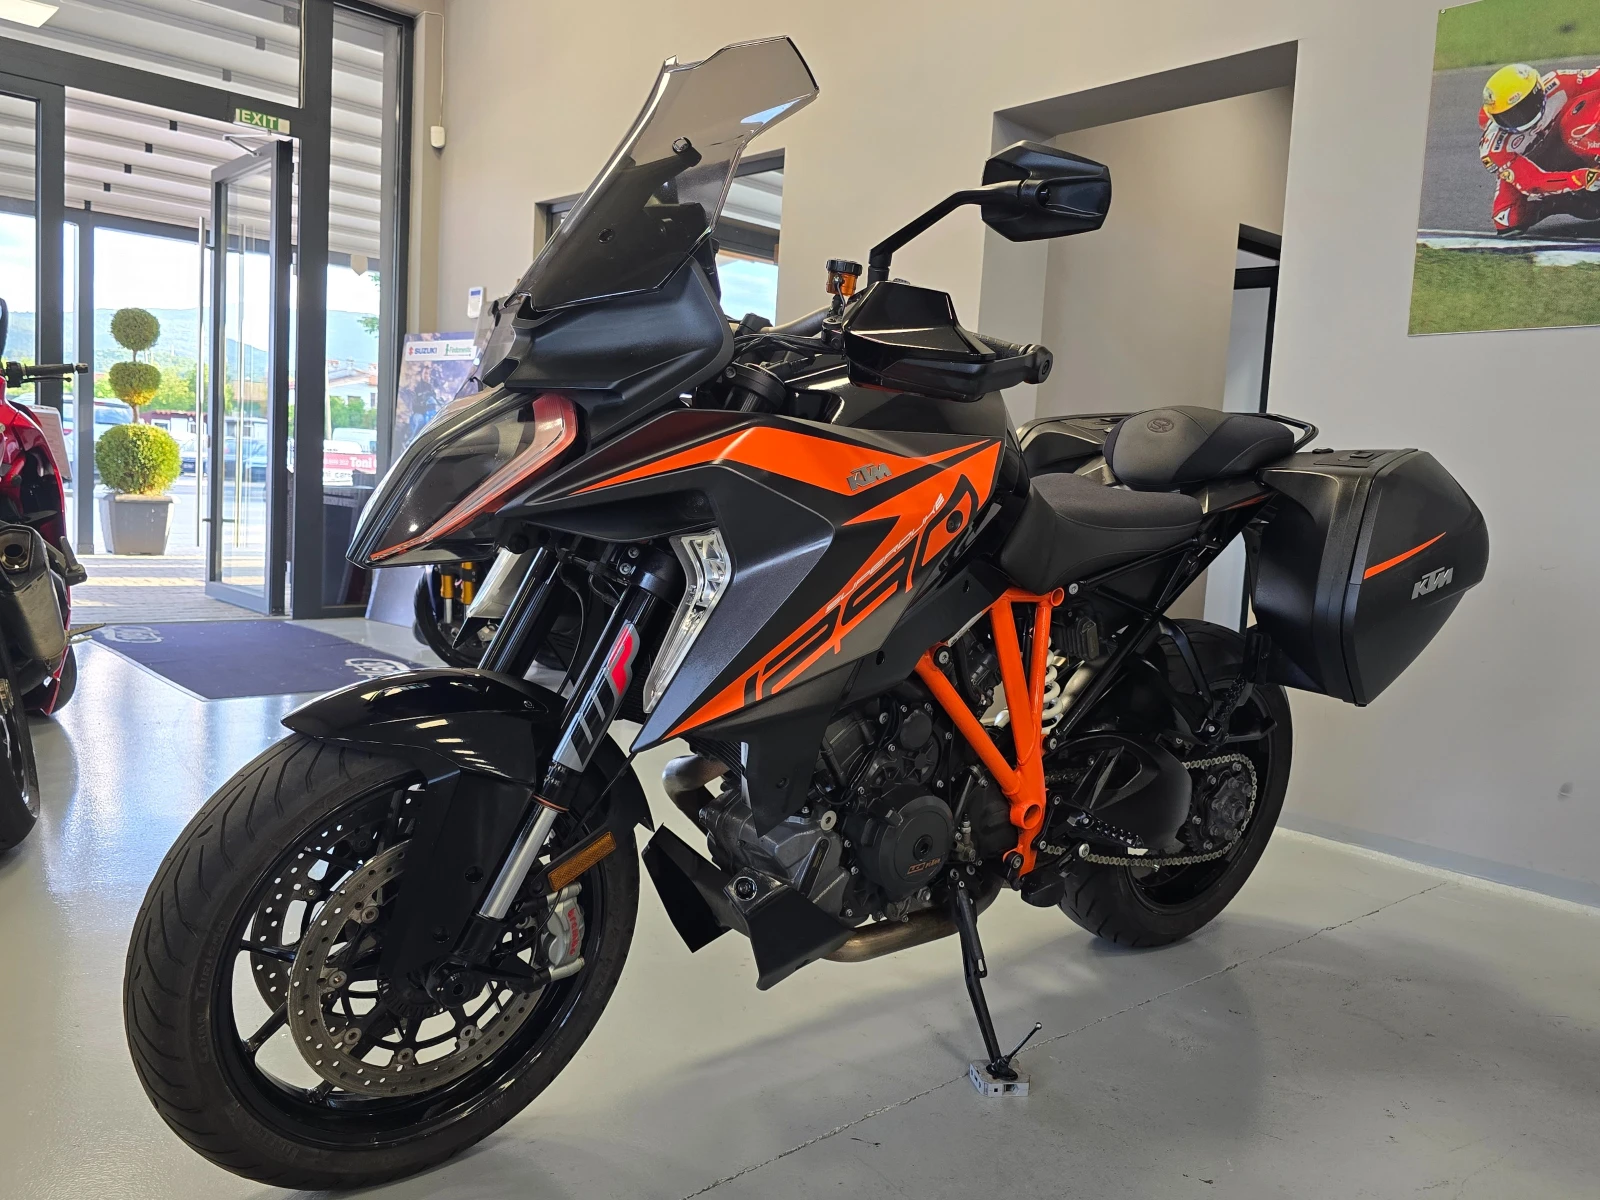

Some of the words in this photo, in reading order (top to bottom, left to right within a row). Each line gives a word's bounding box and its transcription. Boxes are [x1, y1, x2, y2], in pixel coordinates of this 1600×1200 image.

[241, 109, 277, 129] EXIT
[414, 347, 437, 355] SUZUKI
[349, 456, 373, 469] Toni
[846, 462, 893, 491] KTM
[1410, 566, 1454, 601] KTM
[567, 907, 580, 957] brembo
